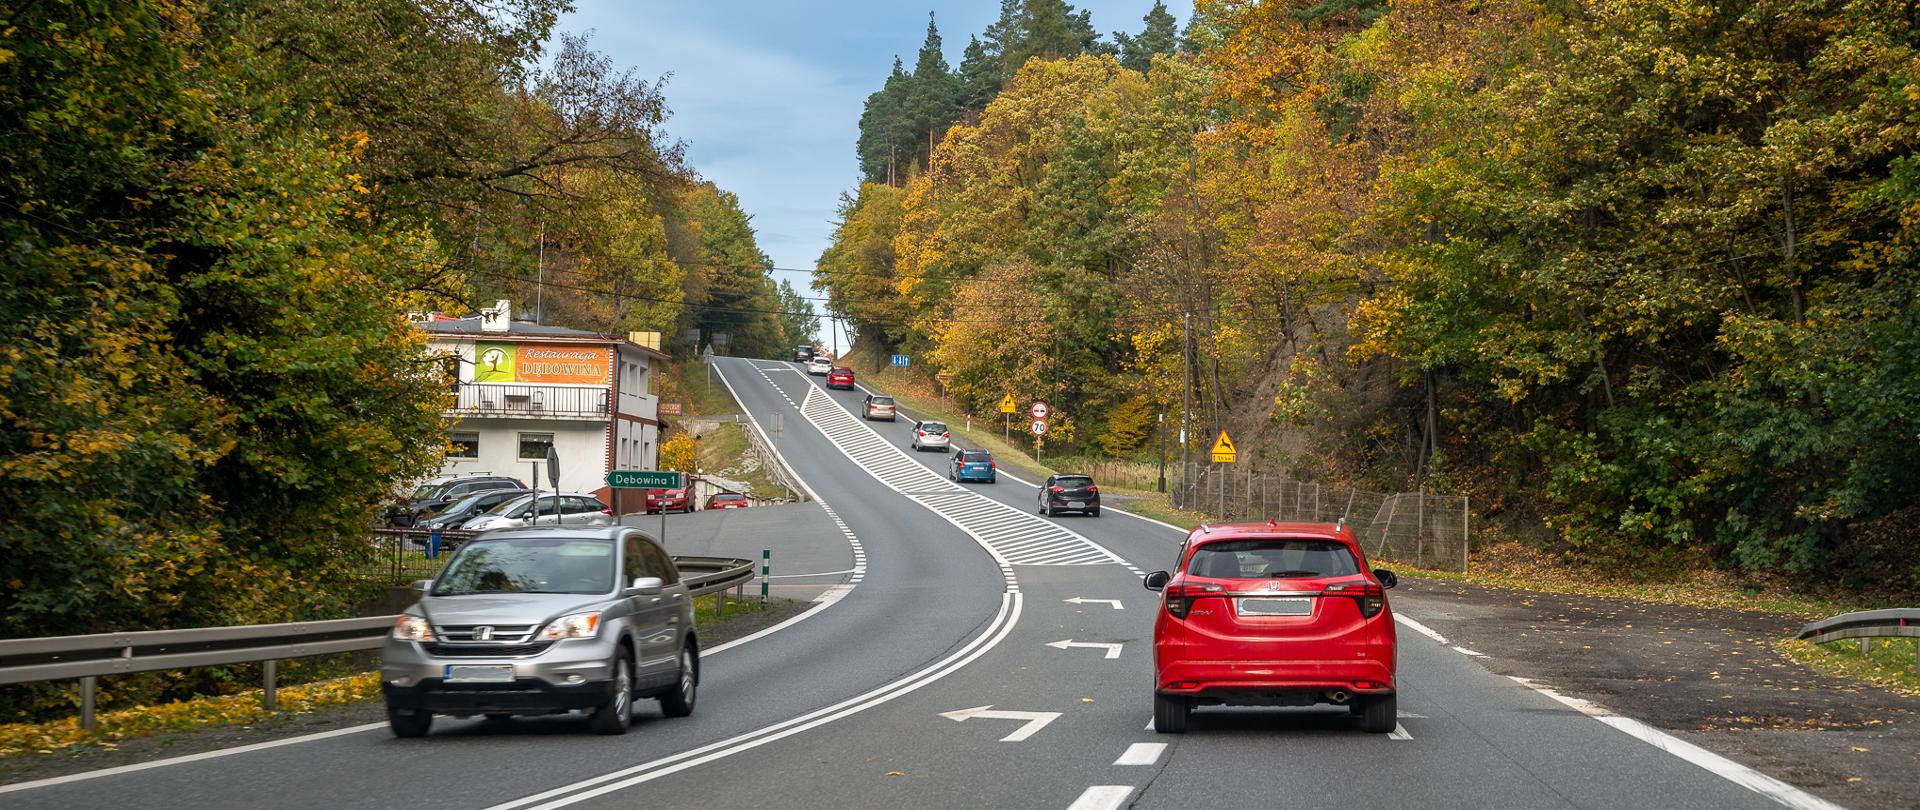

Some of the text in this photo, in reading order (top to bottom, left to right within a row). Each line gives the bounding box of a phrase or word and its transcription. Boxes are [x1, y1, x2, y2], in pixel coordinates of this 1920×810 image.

[525, 349, 599, 362] Restauracja
[522, 362, 602, 377] DĘBOWINA
[1034, 423, 1045, 432] 70
[615, 474, 675, 486] Dębowina 1
